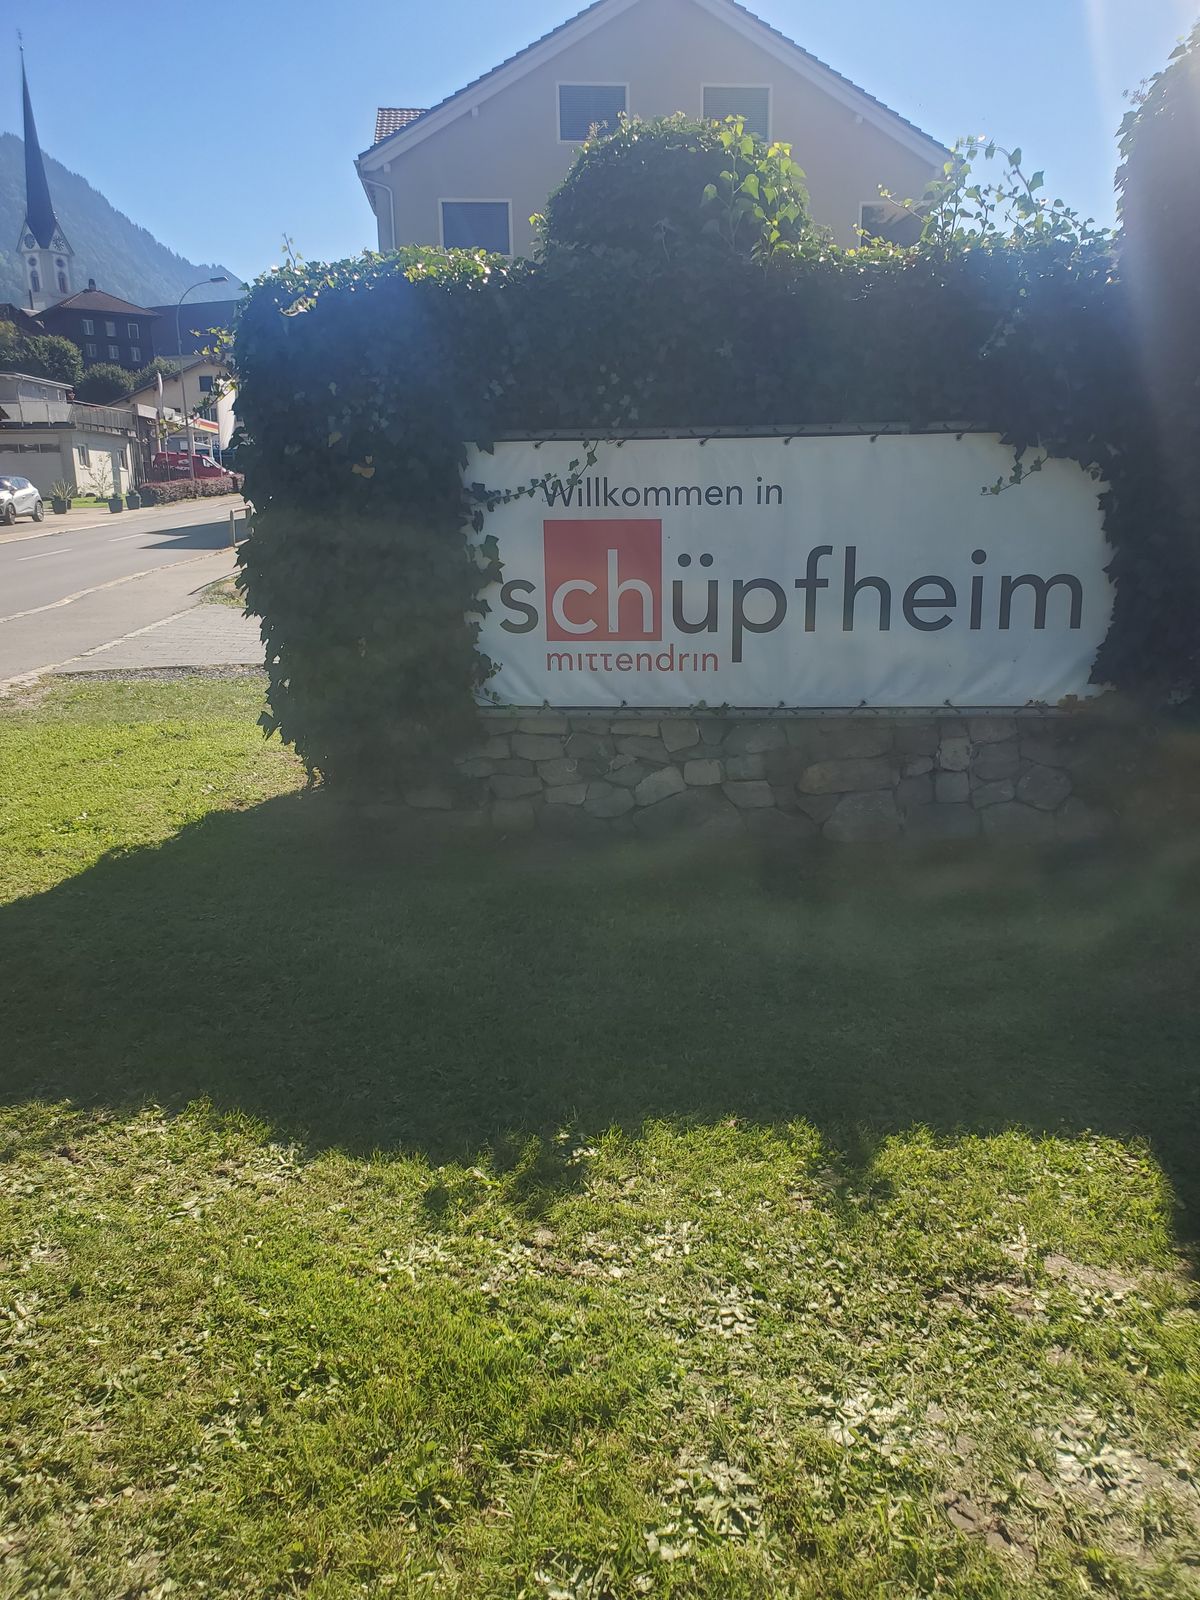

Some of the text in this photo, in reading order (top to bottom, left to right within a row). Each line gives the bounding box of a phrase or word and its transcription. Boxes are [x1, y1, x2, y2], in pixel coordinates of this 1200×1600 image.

[541, 476, 783, 507] Willkommen in
[499, 545, 1084, 663] schüpfheim
